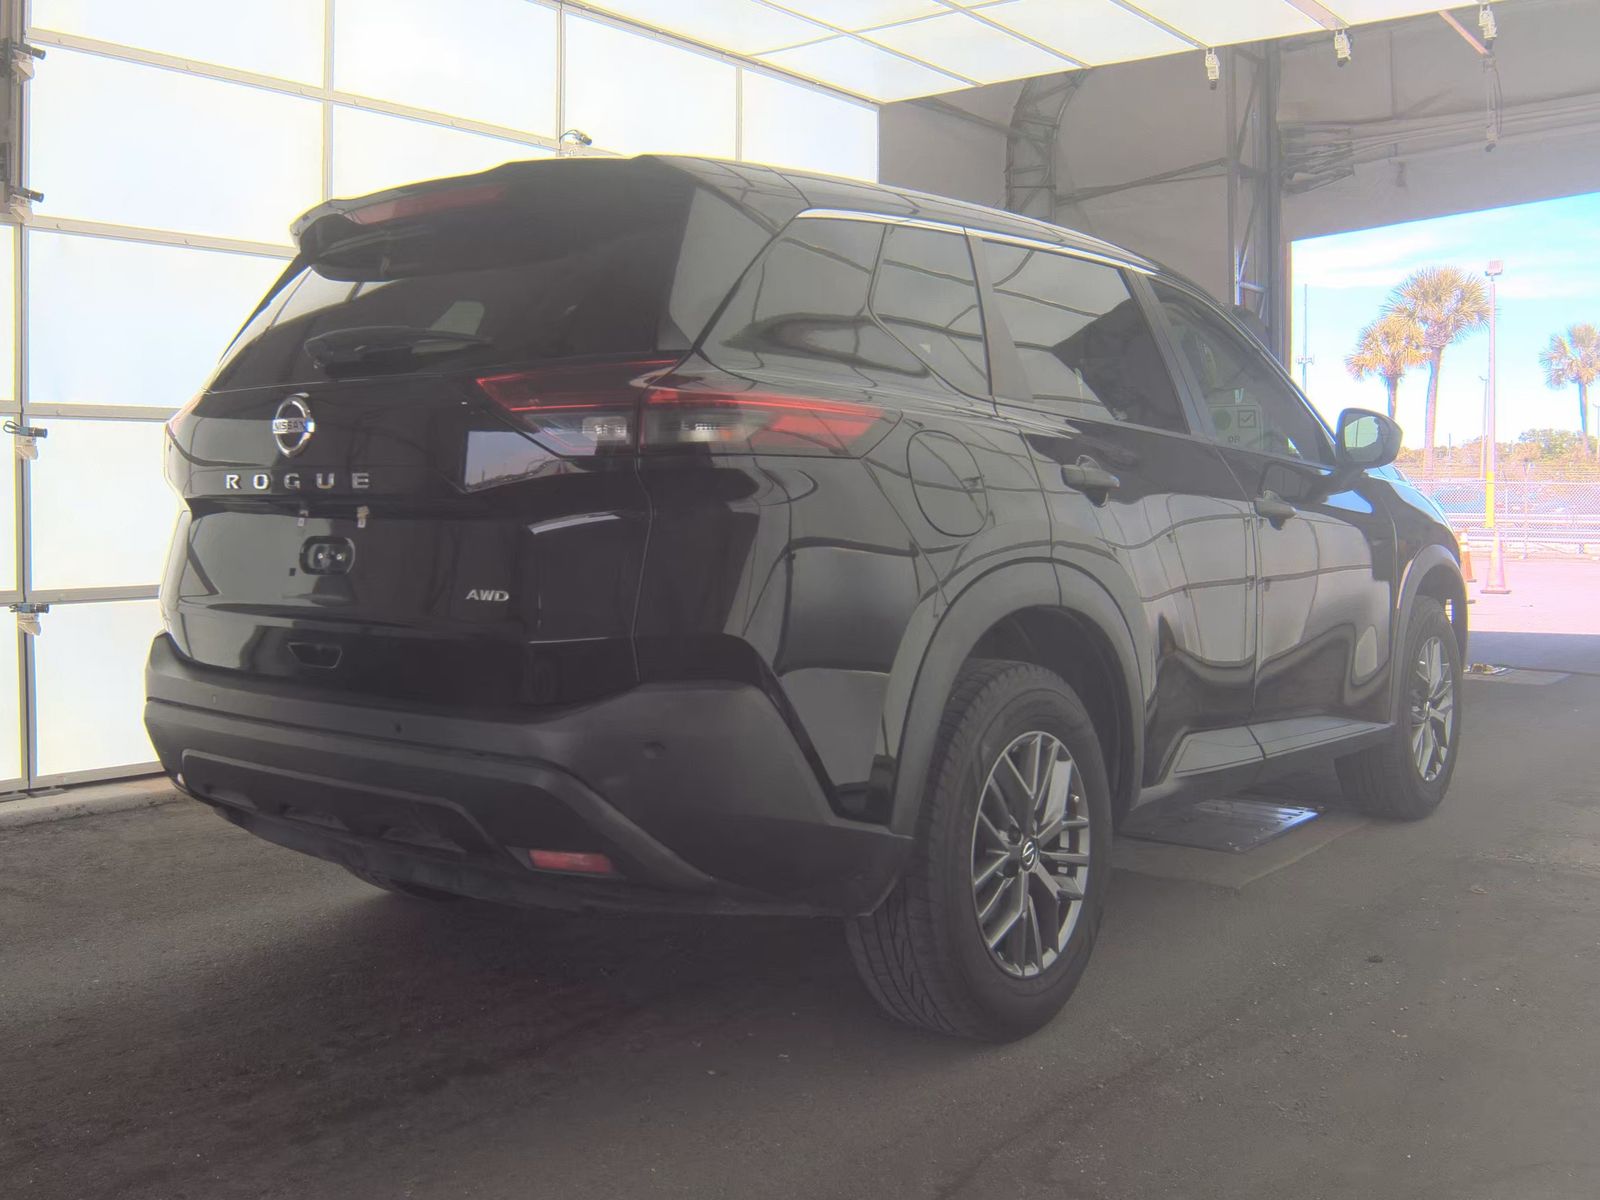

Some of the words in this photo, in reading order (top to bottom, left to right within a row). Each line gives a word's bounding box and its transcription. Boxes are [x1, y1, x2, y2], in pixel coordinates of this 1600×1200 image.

[273, 420, 307, 431] NISSAN
[225, 473, 370, 489] ROGUE
[465, 589, 510, 602] AWD
